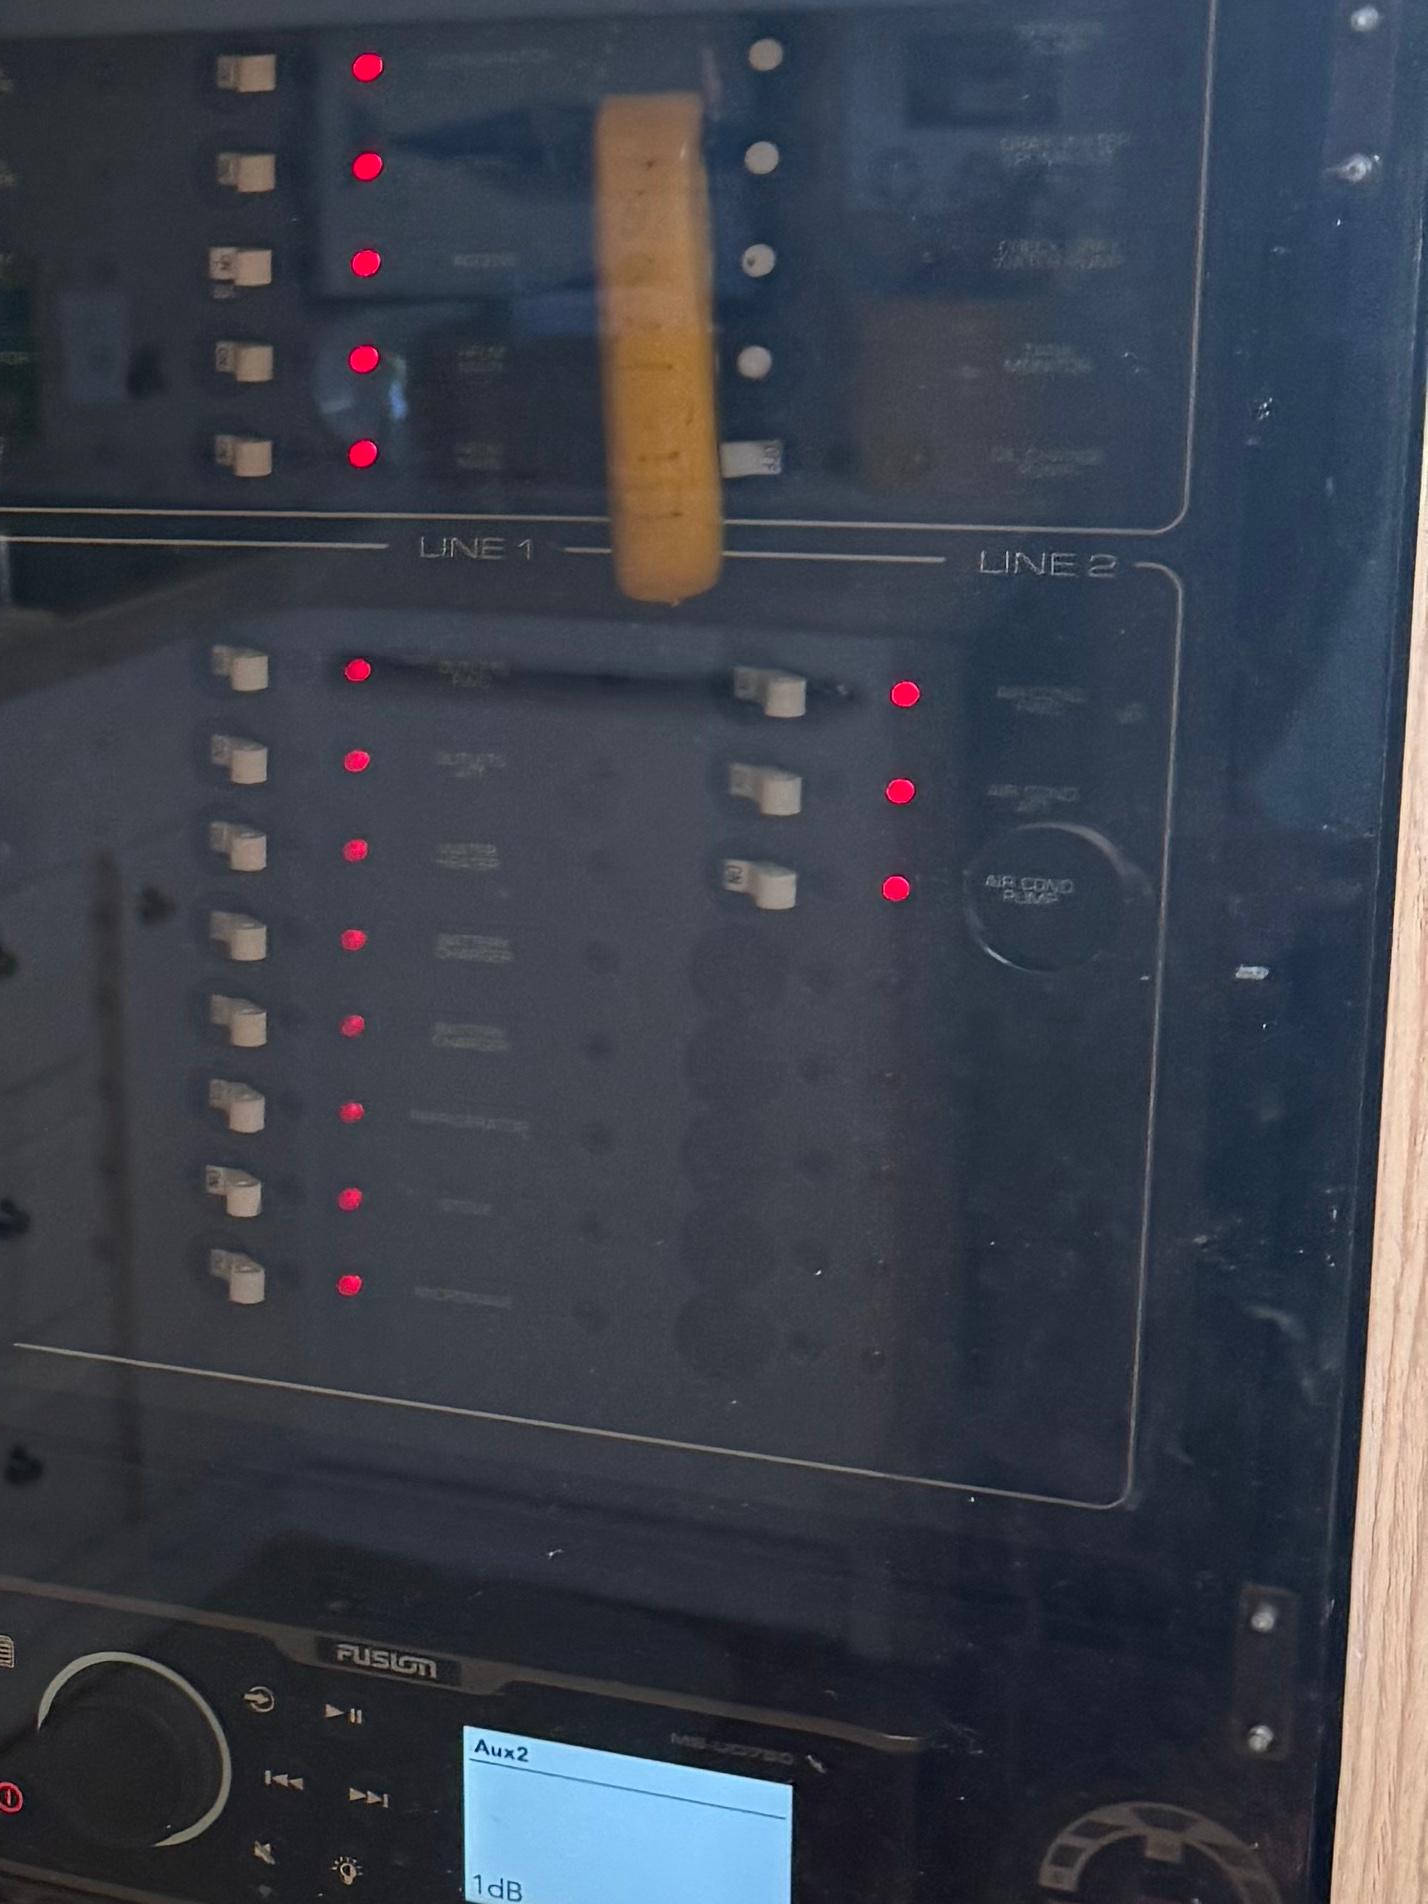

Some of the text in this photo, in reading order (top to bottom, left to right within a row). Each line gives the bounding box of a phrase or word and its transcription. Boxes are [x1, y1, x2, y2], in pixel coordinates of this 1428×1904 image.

[419, 536, 535, 563] LINE 1
[977, 550, 1118, 580] LINE 2
[985, 874, 1075, 894] AIR COND
[1003, 889, 1060, 905] PUMP
[336, 1642, 438, 1678] FUSION
[474, 1737, 531, 1764] Aux2
[472, 1873, 524, 1904] 1dB
